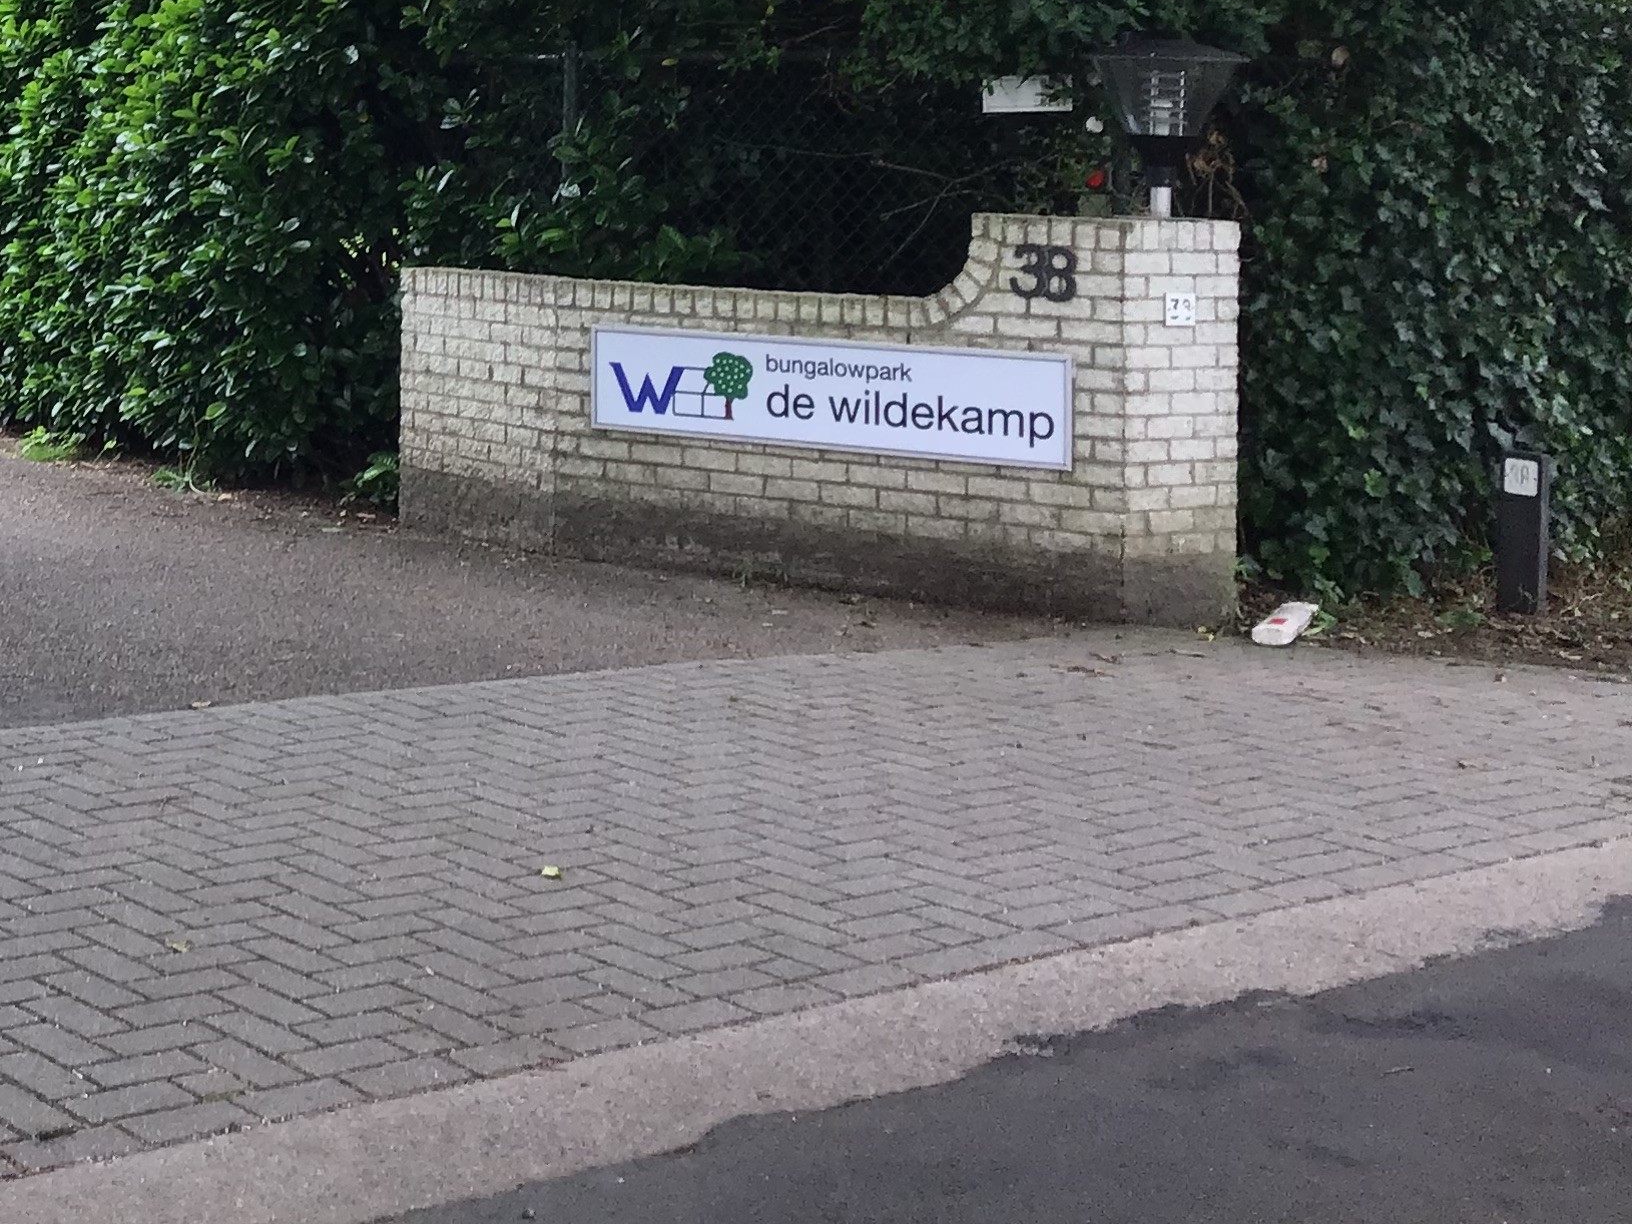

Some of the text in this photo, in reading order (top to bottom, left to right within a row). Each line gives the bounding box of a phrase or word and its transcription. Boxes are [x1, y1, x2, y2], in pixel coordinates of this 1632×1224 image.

[1010, 243, 1077, 303] 38
[766, 354, 913, 383] bungalowpark
[767, 384, 1055, 447] de wildekamp
